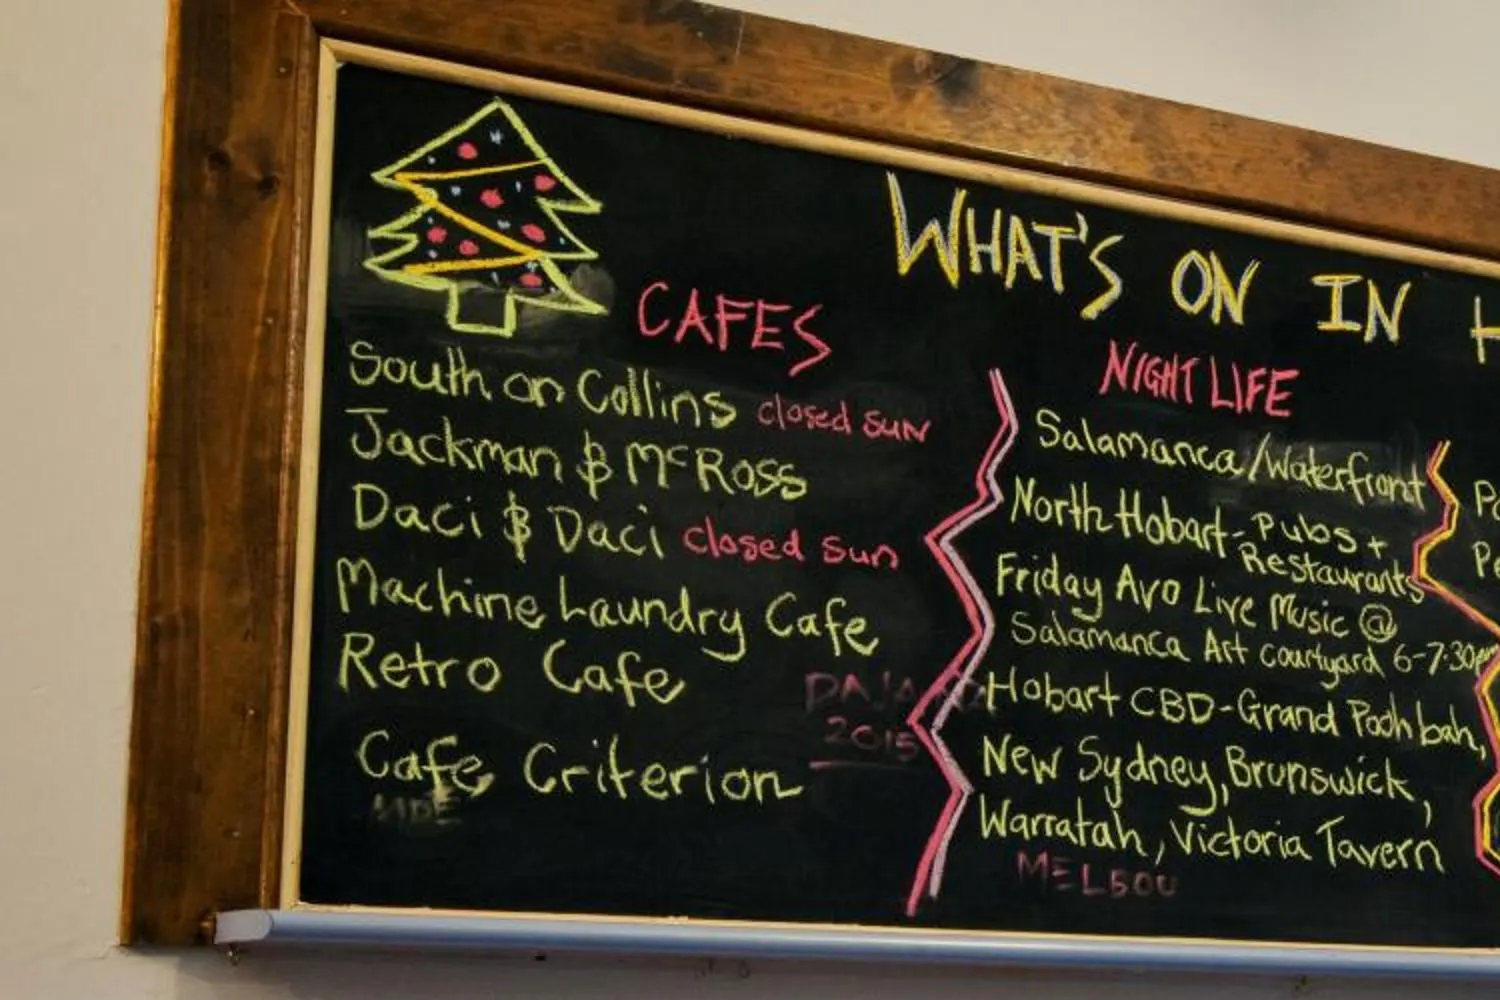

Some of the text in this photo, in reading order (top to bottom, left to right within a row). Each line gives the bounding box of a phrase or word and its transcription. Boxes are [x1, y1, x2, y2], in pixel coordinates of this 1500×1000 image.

[887, 171, 1124, 320] WHAT'S
[1171, 249, 1261, 325] ON
[1311, 272, 1411, 344] IN
[638, 281, 833, 378] CAFES
[346, 341, 491, 400] South
[503, 372, 564, 405] on
[576, 367, 737, 429] Collins
[757, 392, 851, 435] closed
[1100, 339, 1300, 418] NIGHT LIFE
[346, 408, 562, 484] Jackman
[353, 483, 483, 540] Daci
[549, 504, 666, 560] Daci
[1010, 476, 1113, 535] North
[1251, 511, 1357, 555] Pubs
[336, 557, 879, 662] Machine Laundry Cafe
[996, 552, 1104, 623] Friday
[1194, 575, 1257, 628] Live
[1270, 592, 1349, 639] Music
[1358, 604, 1398, 643] @
[1237, 541, 1424, 604] Restaurants
[337, 631, 686, 707] Retro Cafe
[1009, 610, 1191, 663] Salamanca
[1203, 626, 1249, 666] Art
[986, 671, 1120, 719] Hobart
[357, 730, 804, 803] Cafe Criterion
[982, 735, 1063, 783] New
[1169, 819, 1312, 868] Victoria
[1318, 816, 1446, 874] Tavern
